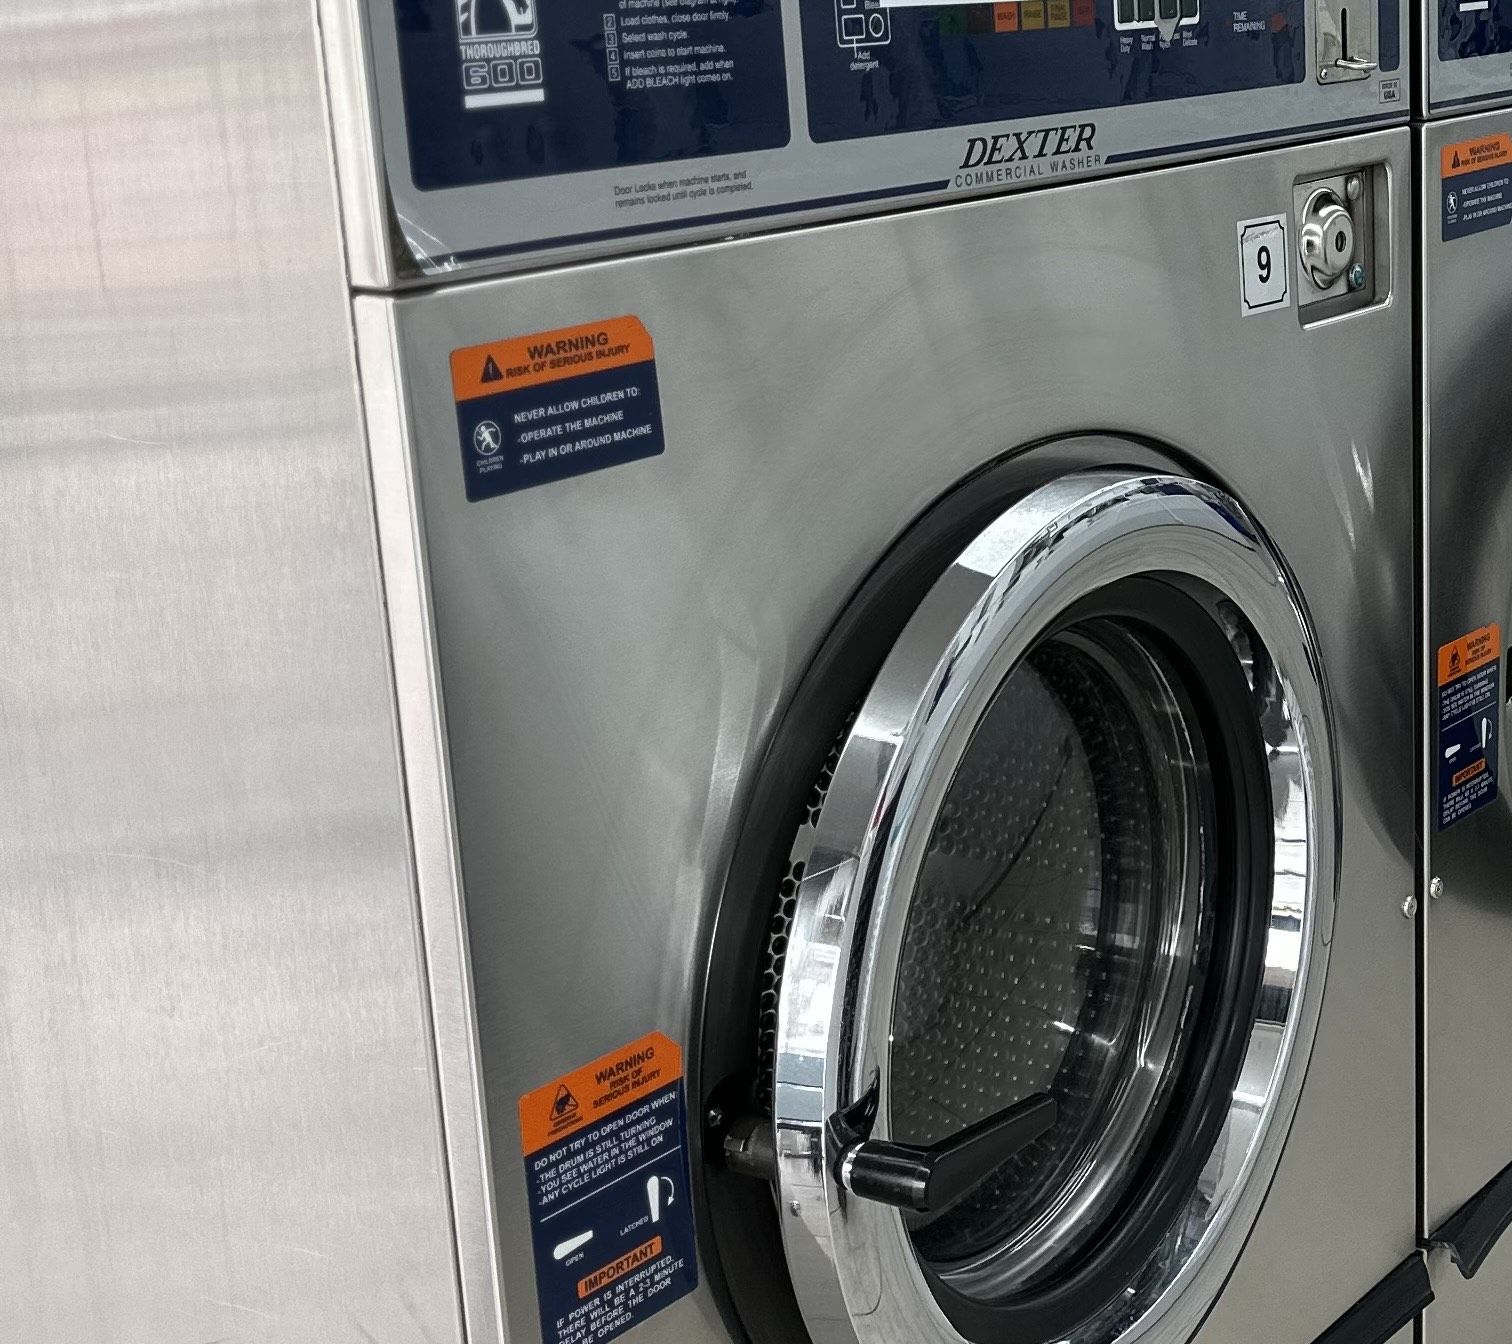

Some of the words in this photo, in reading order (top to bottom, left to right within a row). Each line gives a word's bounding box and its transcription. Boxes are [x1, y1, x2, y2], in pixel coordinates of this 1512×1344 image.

[621, 16, 640, 27] Load
[1233, 11, 1249, 21] TIME
[460, 40, 540, 60] THOROUGHBRED
[462, 58, 544, 89] 600
[959, 122, 1096, 169] DEXTER
[955, 163, 1044, 188] COMMERCIAL
[1050, 154, 1101, 174] WASHER
[1257, 245, 1271, 284] 9
[505, 361, 531, 379] RISK
[533, 359, 548, 373] OF
[549, 351, 594, 370] SERIOUS
[596, 344, 631, 360] INJURY
[528, 331, 608, 361] WARNING
[514, 407, 545, 424] NEVER
[547, 401, 579, 417] ALLOW
[581, 391, 625, 409] CHILDREN
[565, 420, 582, 434] THE
[584, 410, 624, 429] MACHINE
[549, 447, 558, 459] IN
[559, 442, 573, 455] OR
[575, 433, 612, 453] AROUND
[613, 423, 653, 443] MACHINE
[595, 1046, 655, 1085] WARNING
[609, 1075, 631, 1091] RISK
[631, 1067, 643, 1080] OF
[592, 1085, 631, 1109] SERIOUS
[631, 1068, 662, 1090] INJURY
[534, 1158, 548, 1171] DO
[549, 1147, 568, 1163] NOT
[569, 1139, 586, 1154] TRY
[587, 1131, 600, 1144] TO
[601, 1119, 625, 1137] OPEN
[625, 1105, 650, 1124] DOOR
[558, 1155, 585, 1173] DRUM
[585, 1149, 595, 1160] IS
[595, 1137, 619, 1155] STILL
[620, 1116, 657, 1140] TURNING
[561, 1168, 578, 1184] SEE
[580, 1153, 610, 1175] WATER
[610, 1146, 620, 1158] IN
[620, 1138, 638, 1152] THE
[638, 1118, 674, 1143] WINDOW
[561, 1175, 590, 1194] CYCLE
[591, 1161, 616, 1179] LIGHT
[617, 1154, 626, 1164] IS
[627, 1142, 650, 1159] STILL
[651, 1135, 664, 1147] ON
[565, 1252, 585, 1267] OPEN
[584, 1241, 656, 1294] IMPORTANT
[556, 1318, 565, 1329] IF
[568, 1297, 600, 1322] POWER
[603, 1290, 612, 1301] IS
[558, 1315, 586, 1338] THERE
[589, 1303, 610, 1320] WILL
[614, 1293, 626, 1304] BE
[629, 1287, 636, 1297] A
[638, 1279, 651, 1291] 2-3
[654, 1258, 685, 1282] MINUTE
[590, 1305, 624, 1331] BEFORE
[628, 1293, 644, 1308] THE
[647, 1277, 672, 1297] DOOR
